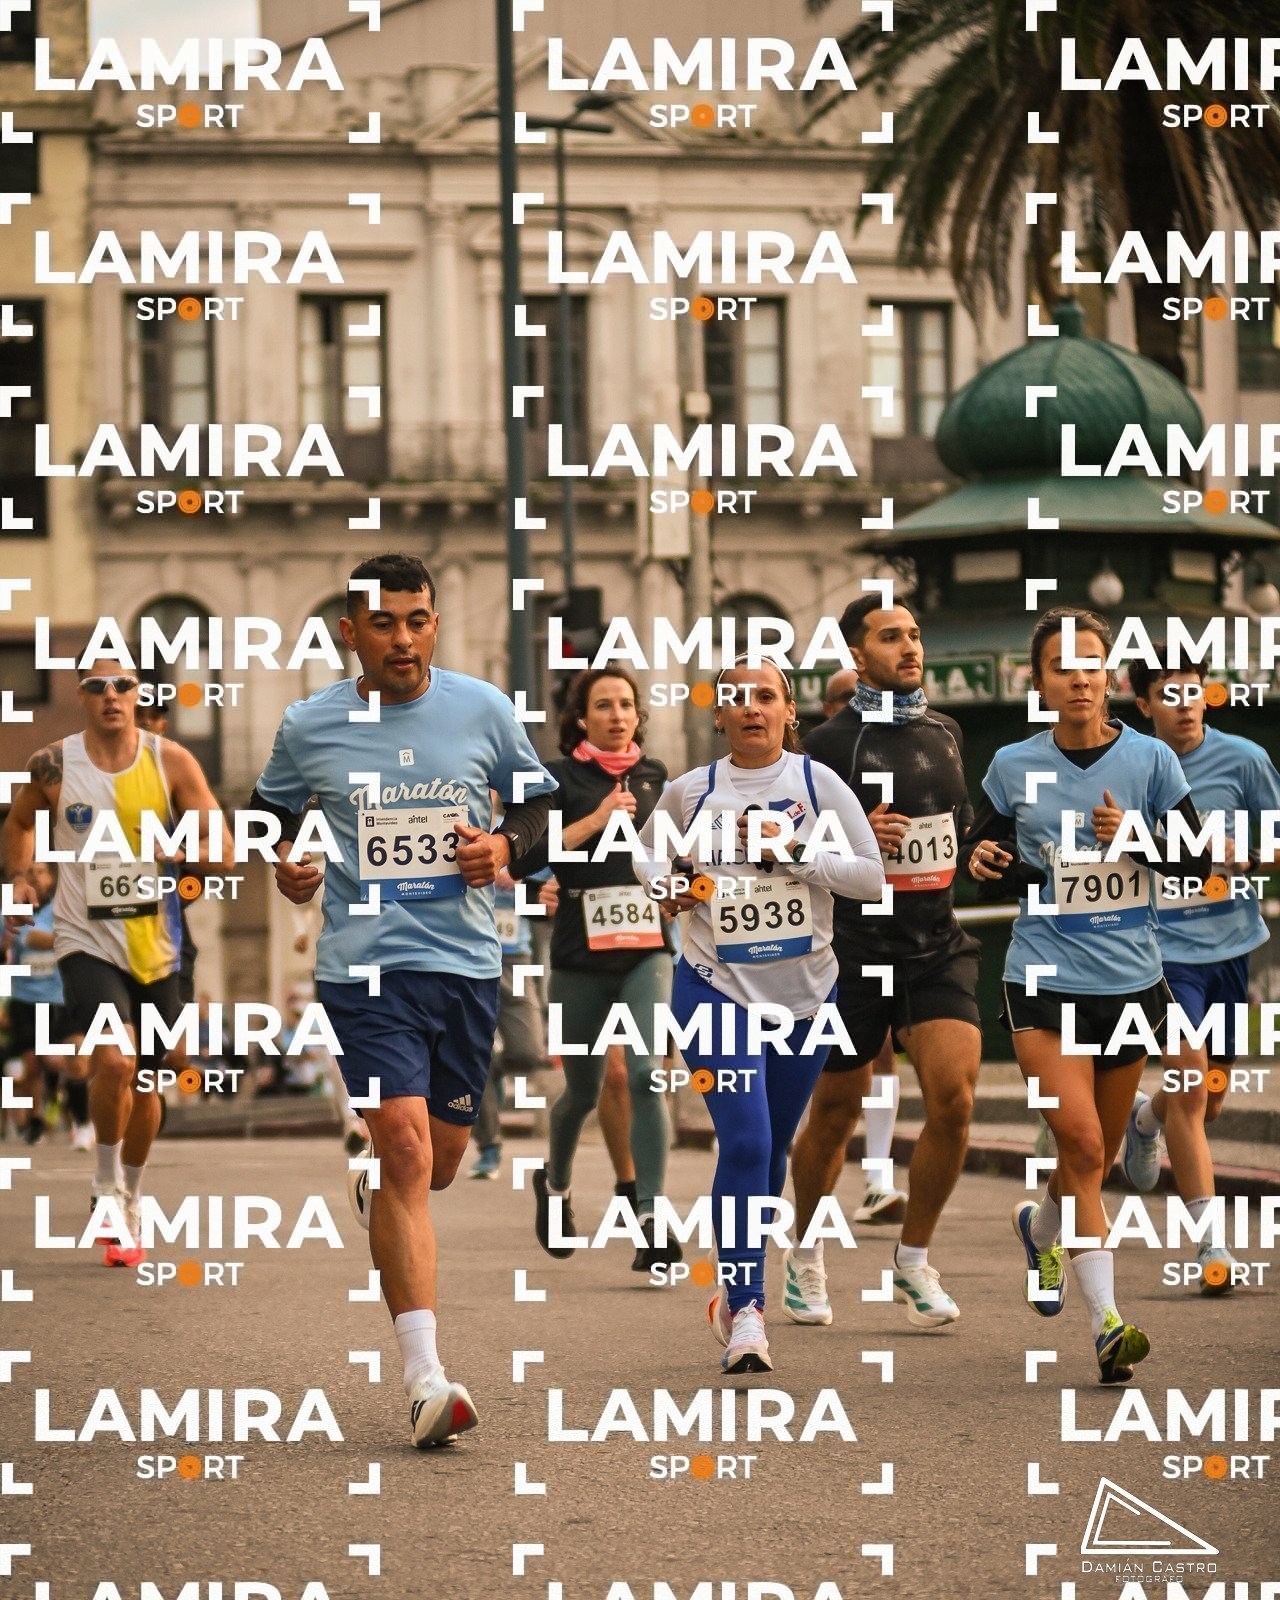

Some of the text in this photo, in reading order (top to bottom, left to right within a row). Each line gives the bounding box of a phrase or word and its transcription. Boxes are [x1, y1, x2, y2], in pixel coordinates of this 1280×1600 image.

[408, 815, 428, 824] antel
[366, 832, 460, 867] 6533
[888, 834, 954, 865] 4013
[397, 881, 436, 891] Maratón
[754, 885, 773, 894] antel
[1061, 869, 1141, 904] 7901
[591, 902, 655, 927] 4584
[720, 898, 805, 934] 5938
